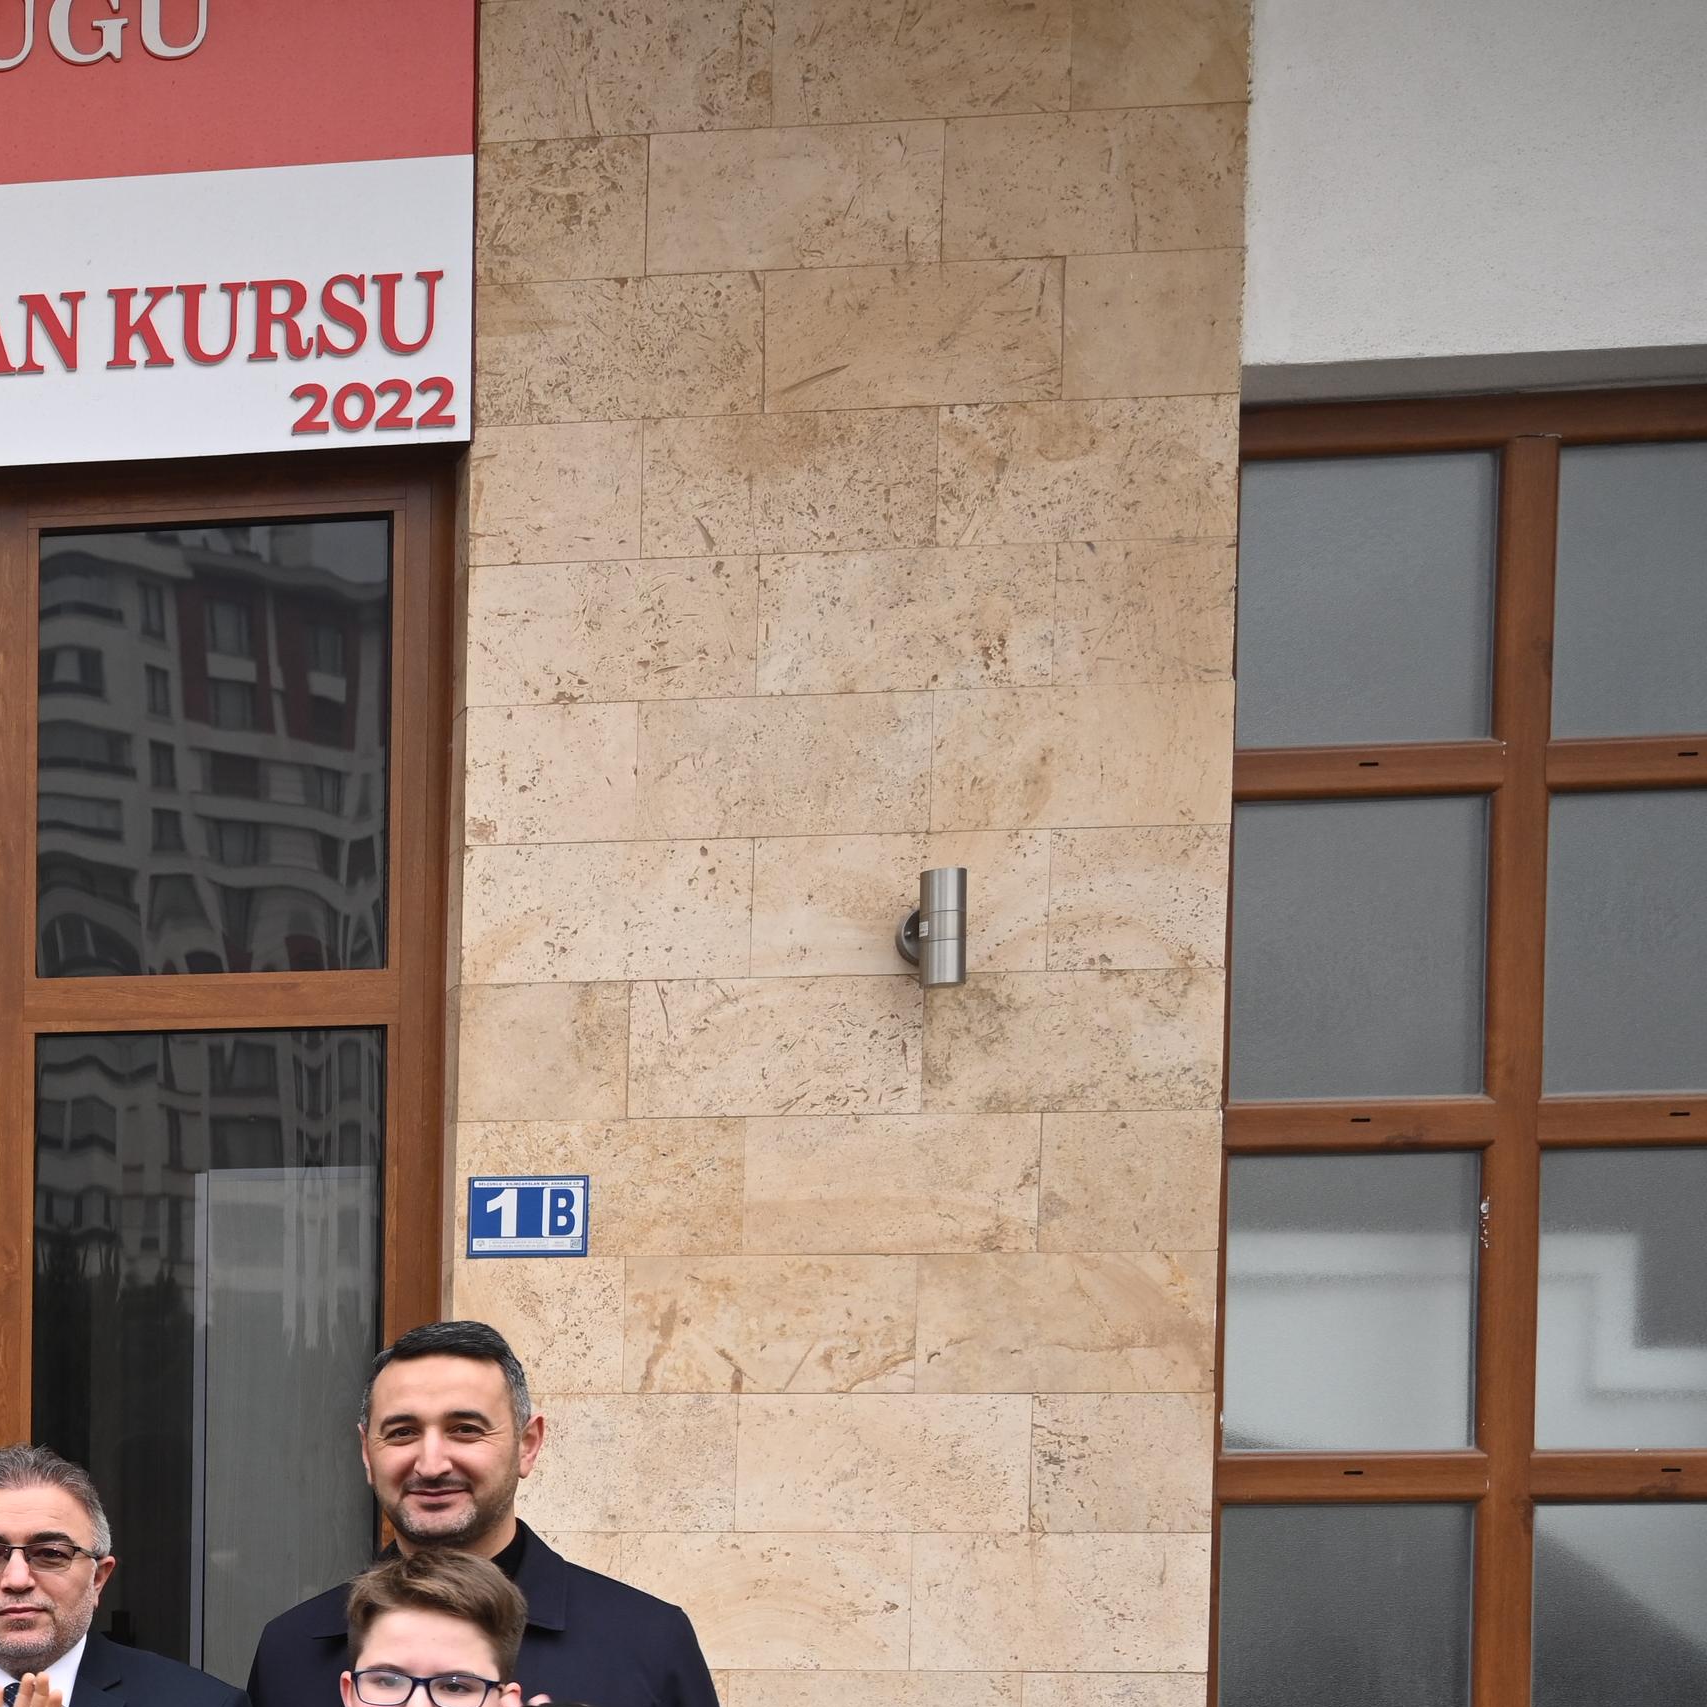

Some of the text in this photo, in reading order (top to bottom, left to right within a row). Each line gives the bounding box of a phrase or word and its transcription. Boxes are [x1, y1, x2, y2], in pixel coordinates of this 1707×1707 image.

[106, 270, 445, 369] KURSU
[291, 376, 457, 435] 2022
[486, 1188, 519, 1237] 1
